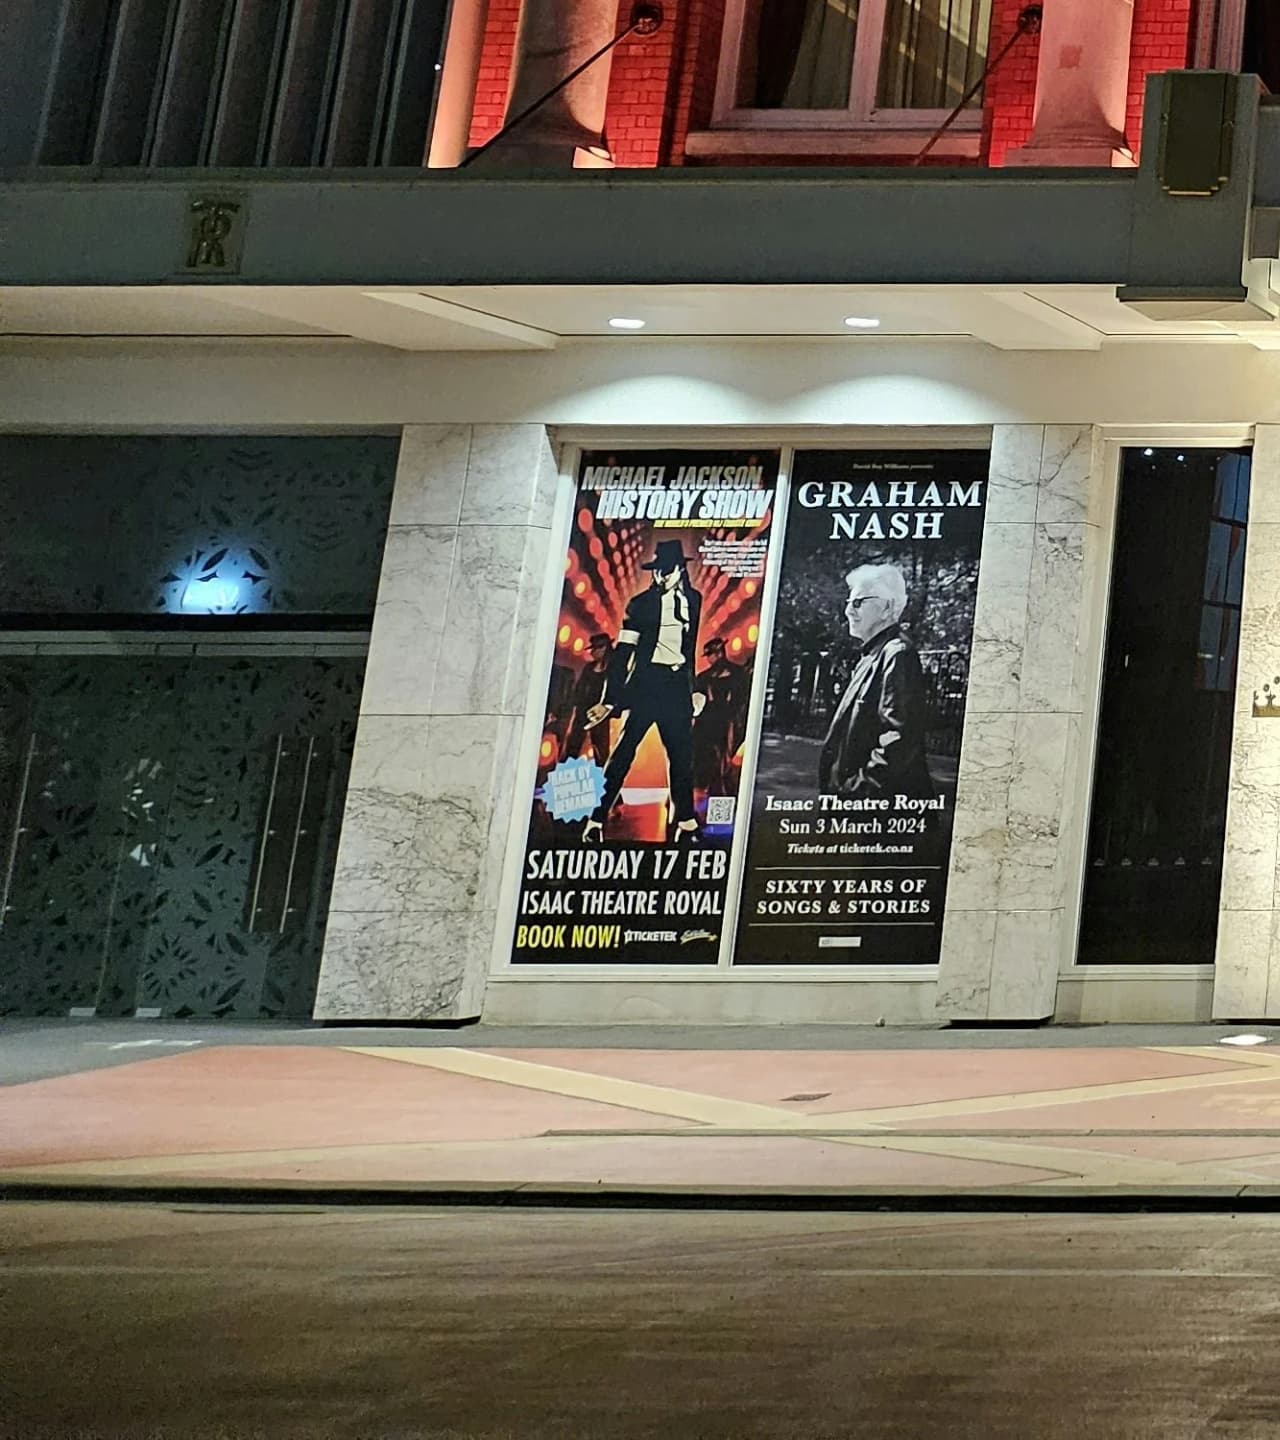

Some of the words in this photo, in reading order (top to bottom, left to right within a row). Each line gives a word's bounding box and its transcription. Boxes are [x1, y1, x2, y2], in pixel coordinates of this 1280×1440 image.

[581, 466, 666, 490] MICHAEL
[669, 465, 763, 490] JACKSON
[596, 490, 698, 520] HISTORY
[698, 489, 774, 519] SHOW
[798, 481, 983, 508] GRAHAM
[829, 512, 944, 539] NASH
[765, 795, 814, 811] Isaac
[818, 794, 894, 810] Theatre
[894, 794, 945, 814] Royal
[779, 818, 810, 834] Sun
[815, 819, 825, 834] 3
[829, 818, 881, 834] March
[887, 817, 927, 834] 2024
[787, 843, 825, 854] Tickets
[826, 844, 838, 853] at
[840, 843, 914, 854] ticketek.co.nz
[526, 850, 645, 880] SATURDAY
[653, 850, 679, 880] 17
[685, 850, 727, 880] FEB
[766, 880, 826, 894] SIXTY
[832, 879, 894, 893] YEARS
[900, 879, 927, 893] OF
[521, 891, 577, 915] ISAAC
[580, 891, 663, 915] THEATRE
[664, 891, 722, 915] ROYAL
[756, 900, 822, 914] SONGS
[828, 900, 841, 914] &
[847, 900, 930, 914] STORIES
[516, 925, 567, 948] BOOK
[571, 925, 621, 948] NOW!
[628, 931, 678, 942] TICKETEK
